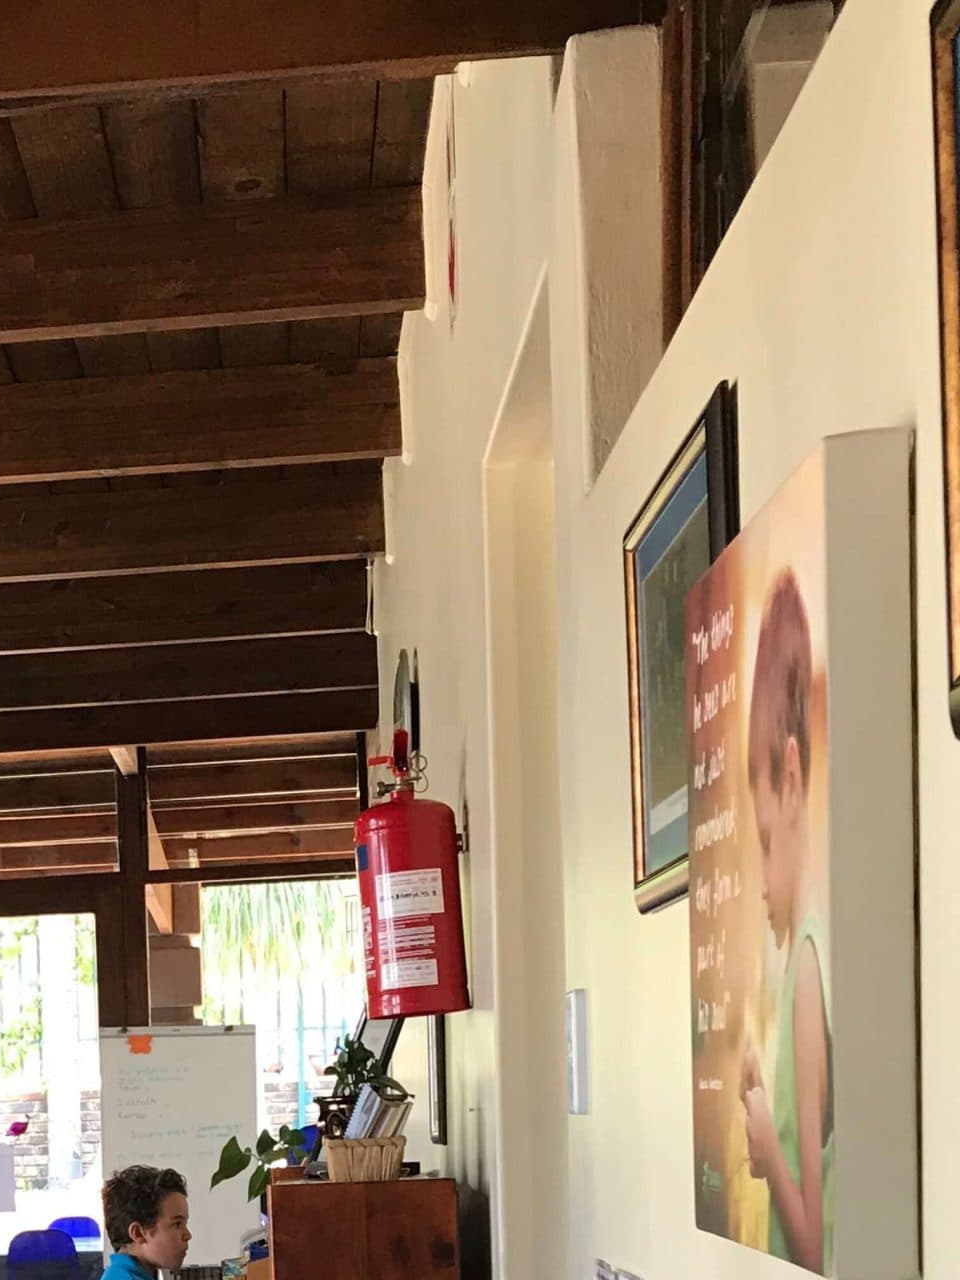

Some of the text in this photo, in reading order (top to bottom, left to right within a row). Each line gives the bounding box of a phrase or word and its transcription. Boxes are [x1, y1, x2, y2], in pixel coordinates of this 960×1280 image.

[693, 694, 702, 733] he
[722, 672, 737, 708] are
[694, 752, 706, 790] not
[734, 870, 742, 897] a
[696, 928, 726, 978] part of
